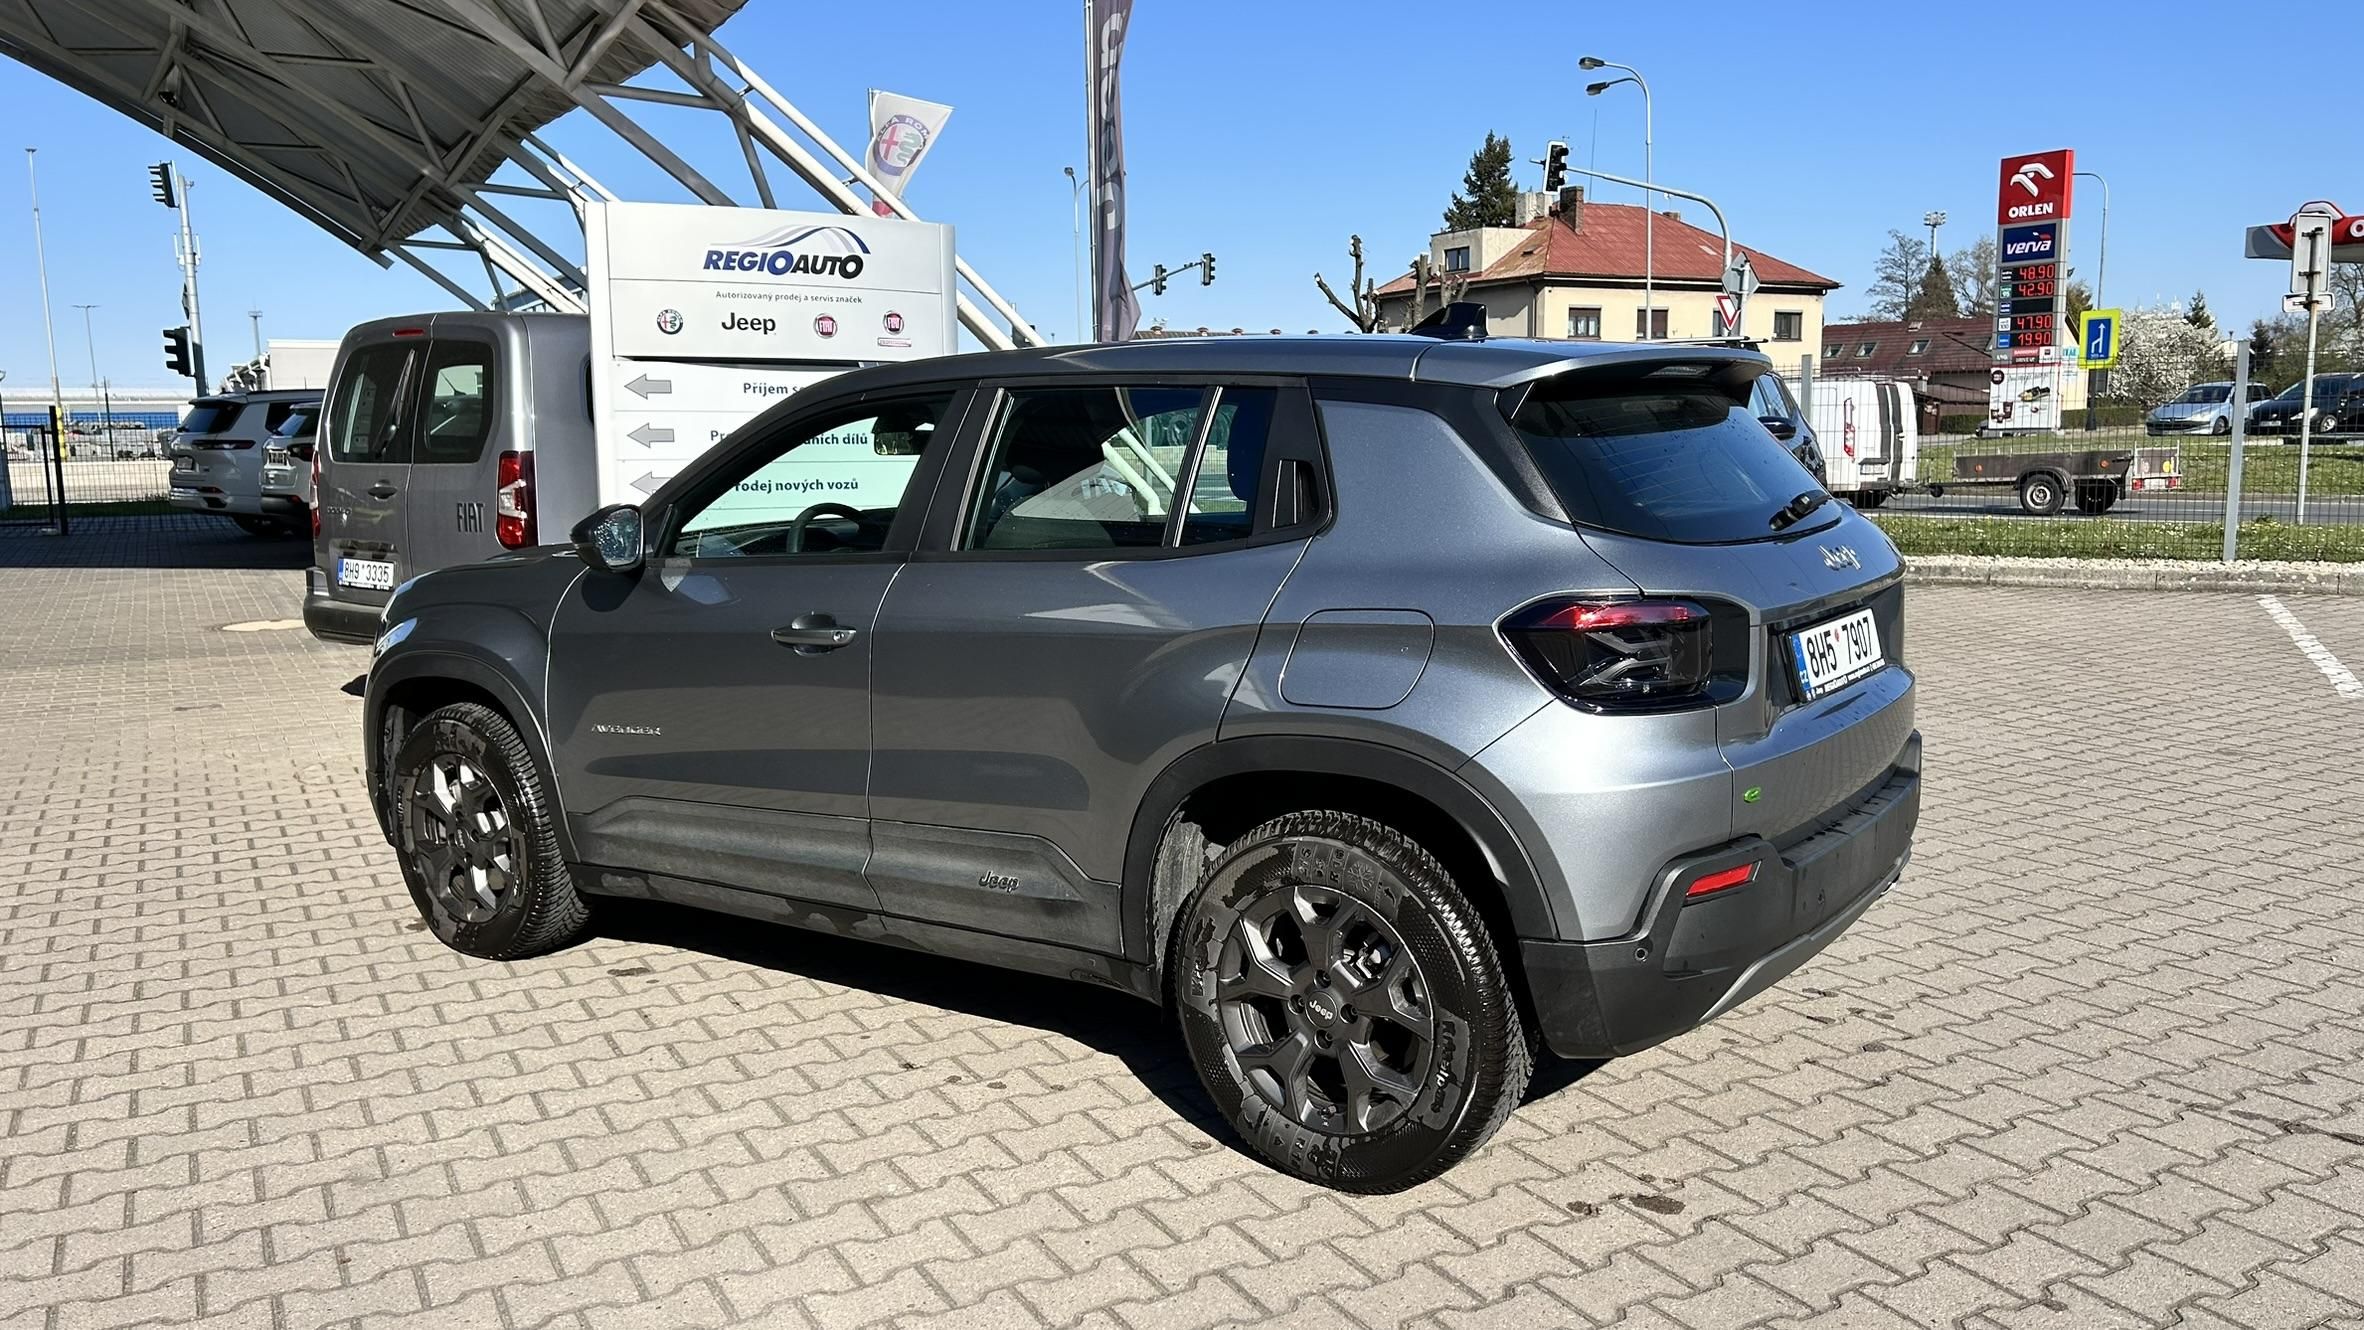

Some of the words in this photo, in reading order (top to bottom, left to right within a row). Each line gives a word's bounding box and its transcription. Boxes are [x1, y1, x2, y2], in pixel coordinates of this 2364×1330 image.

[2008, 202, 2054, 218] ORLEN
[2006, 240, 2052, 255] verva
[703, 250, 864, 280] REGIOAUTO
[2019, 264, 2055, 280] 48.90
[716, 290, 773, 302] Autorizovaný
[775, 293, 802, 303] prodej
[836, 295, 863, 304] značek
[2018, 281, 2054, 297] 42.90
[721, 312, 776, 335] Jeep
[2017, 315, 2052, 330] 47.90
[2017, 331, 2051, 346] 19.90
[743, 382, 788, 397] Příjem
[842, 432, 868, 445] dílů
[775, 478, 824, 494] nových
[827, 478, 859, 490] vozů
[456, 502, 485, 533] FIAT
[344, 561, 360, 579] 8H9
[366, 563, 390, 583] 3335
[1806, 630, 1838, 679] 8H5
[1841, 616, 1873, 665] 7907
[978, 870, 1020, 894] Jeep
[1309, 1000, 1334, 1020] Jeep
